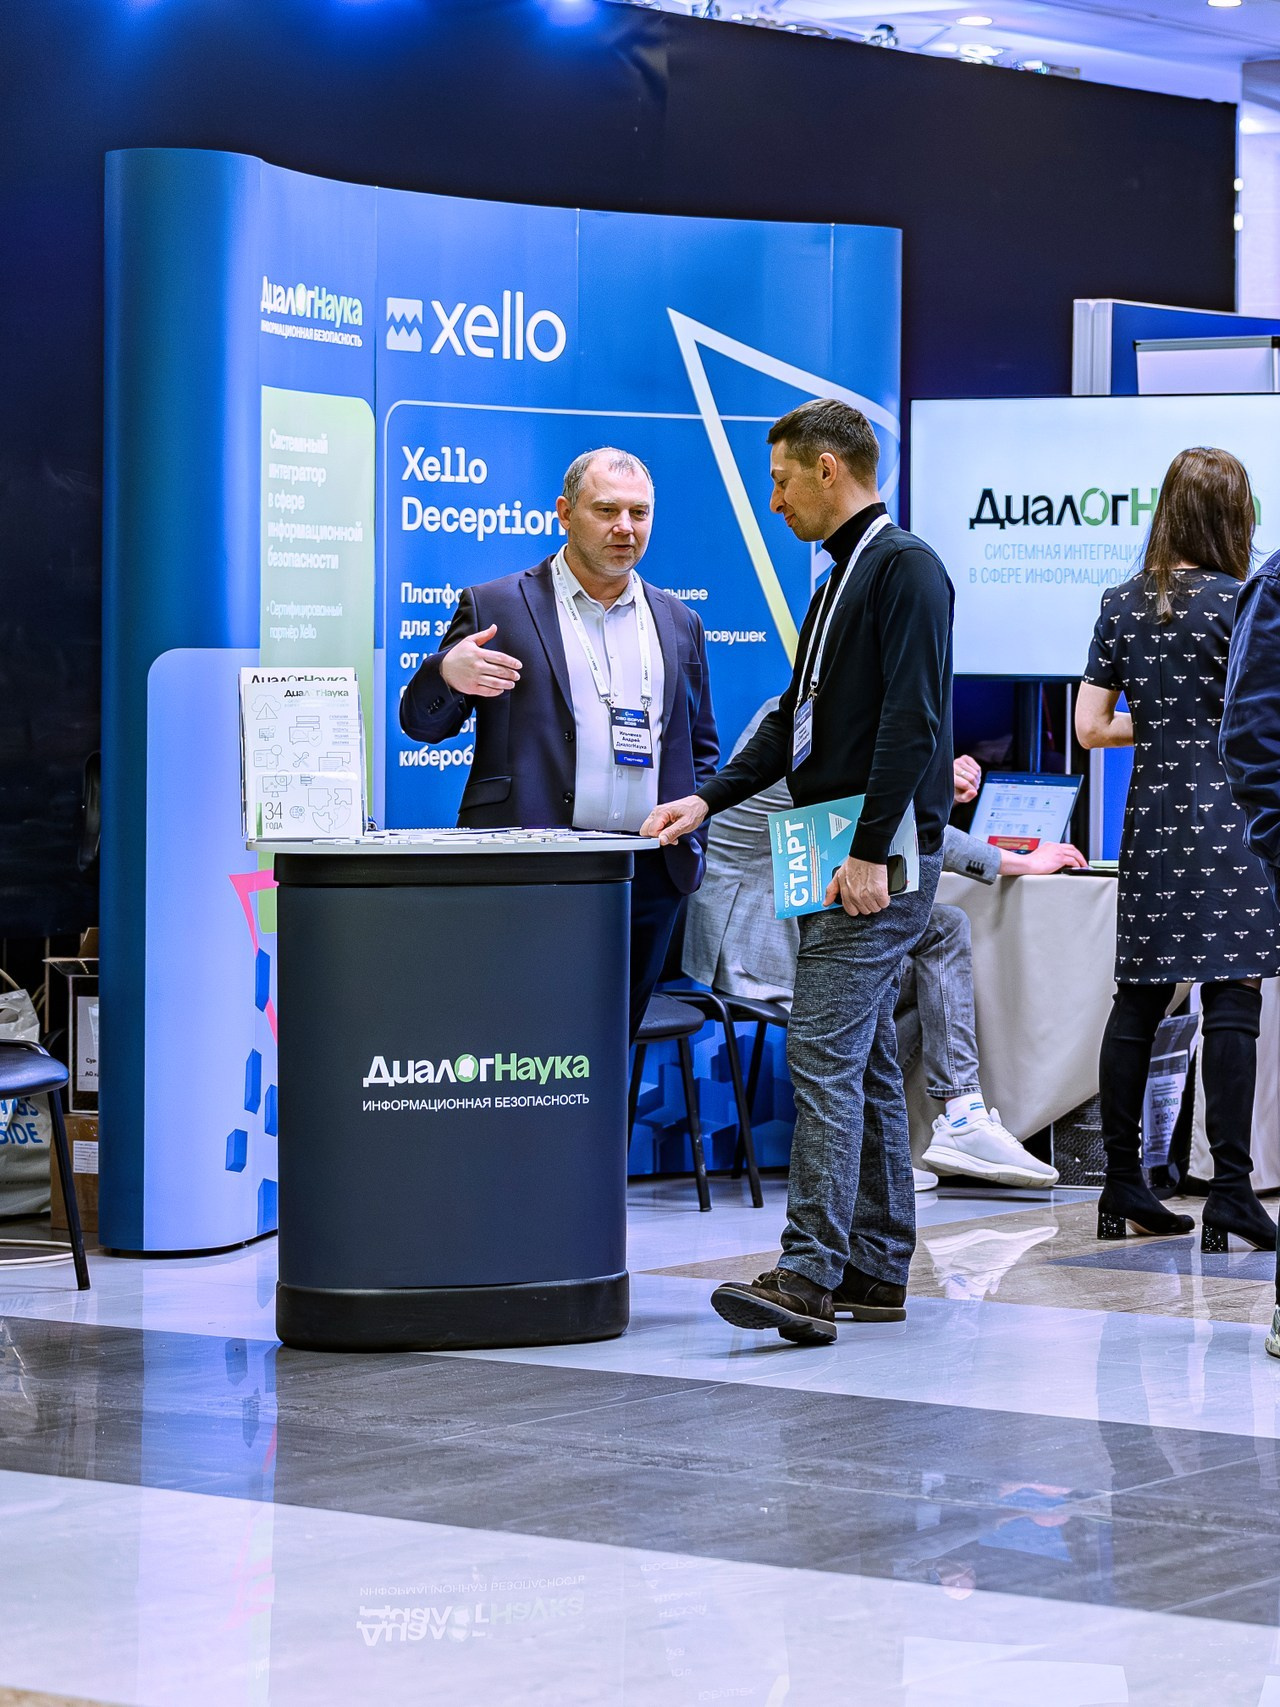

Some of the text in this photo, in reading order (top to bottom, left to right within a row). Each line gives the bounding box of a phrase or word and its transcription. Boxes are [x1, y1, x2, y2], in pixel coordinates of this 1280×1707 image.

[430, 289, 567, 362] xello
[314, 328, 363, 347] БЕЗОПАСНОСТЬ
[269, 428, 328, 454] Системный
[401, 445, 488, 484] Xello
[268, 463, 327, 487] интегратор
[268, 492, 305, 513] в сфере
[401, 496, 567, 541] Deception
[267, 518, 363, 543] информационной
[267, 544, 339, 569] безопасности
[984, 543, 1061, 560] СИСТЕМНАЯ
[969, 567, 1132, 586] В СФЕРЕ ИНФОРМАЦИОН
[399, 620, 430, 639] для
[400, 652, 419, 668] от
[284, 689, 349, 698] ДиалгНаука
[264, 801, 283, 820] 34
[265, 821, 283, 830] ГОДА
[784, 819, 808, 906] СТАРТ
[362, 1093, 590, 1112] ИНФОРМАЦИОННАЯ БЕЗОПАСНОСТЬ
